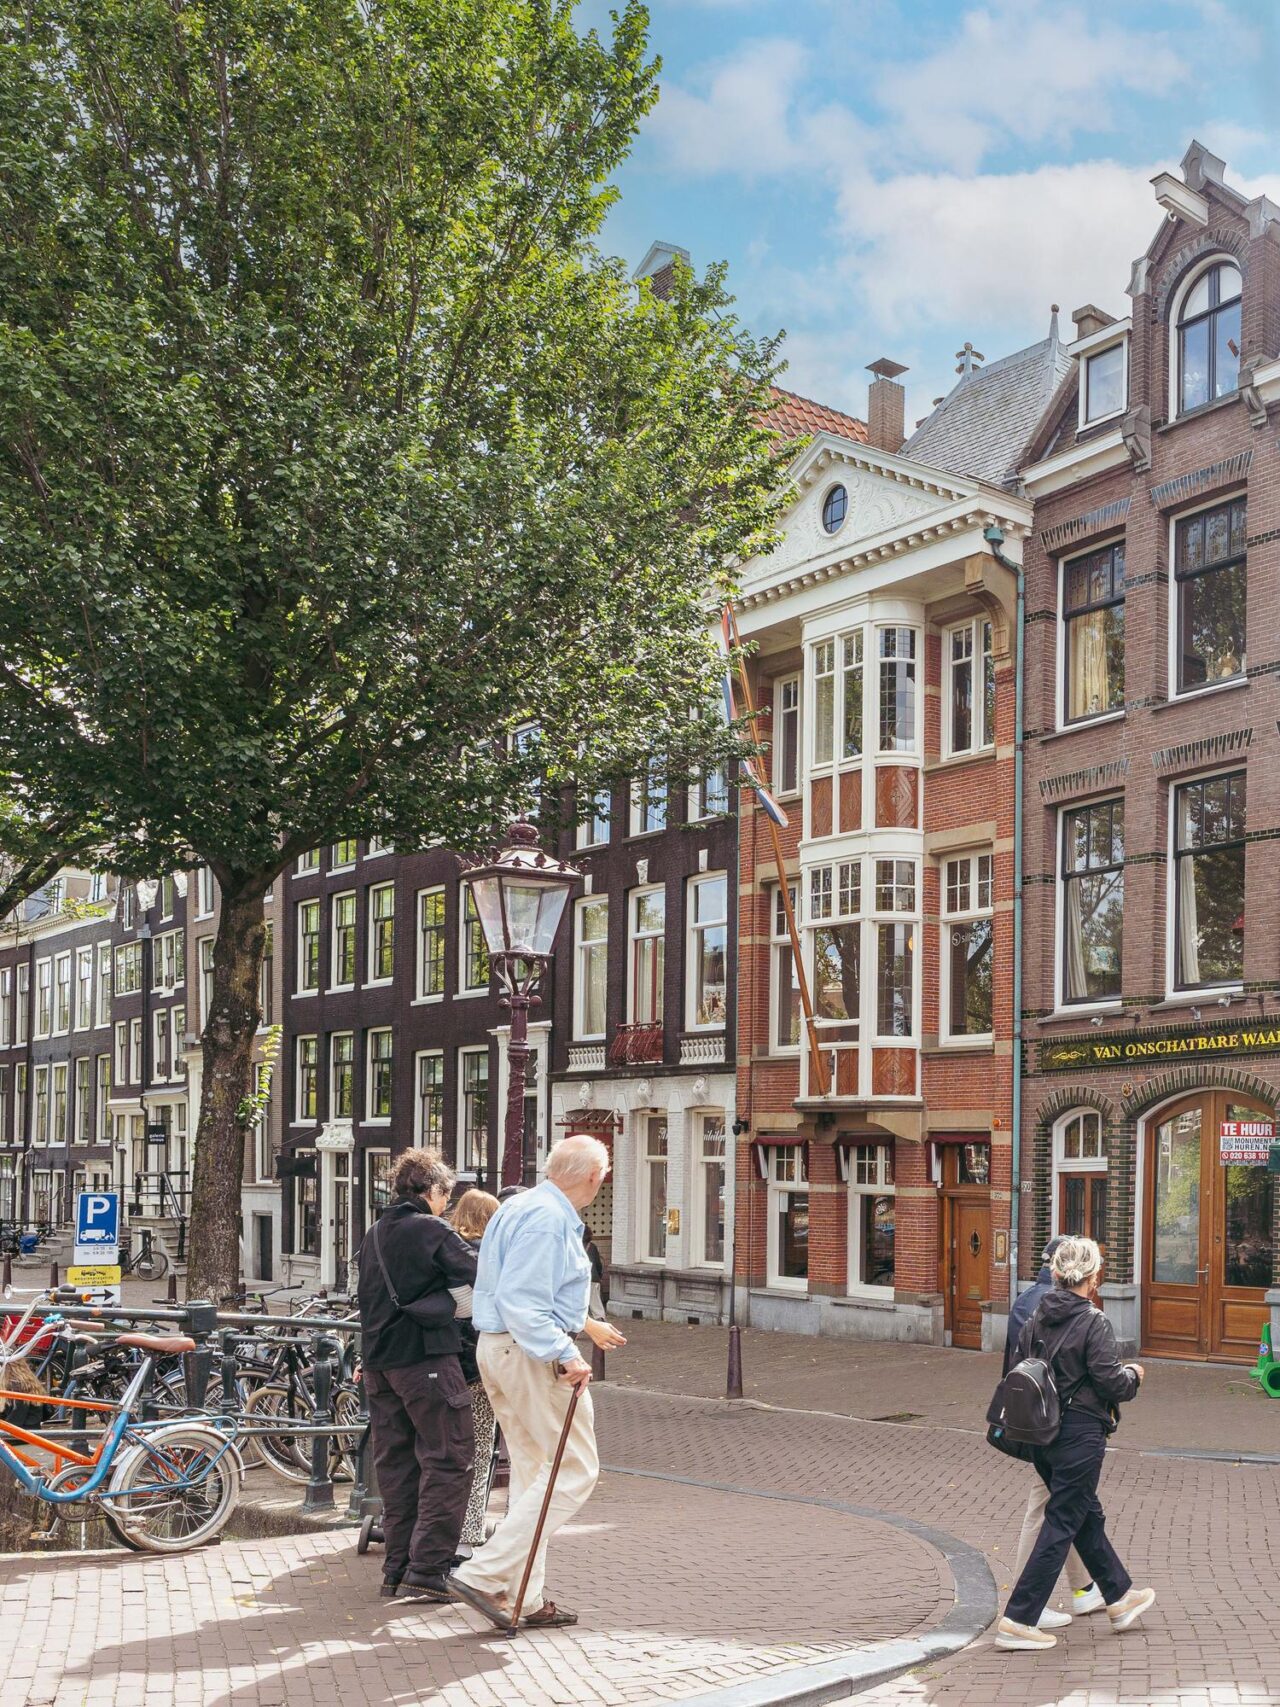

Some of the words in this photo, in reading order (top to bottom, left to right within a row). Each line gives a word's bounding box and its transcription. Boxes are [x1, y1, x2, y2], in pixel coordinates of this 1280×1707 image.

[1093, 1044, 1122, 1059] VAN
[1125, 1034, 1239, 1057] ONSCHATBARE
[1222, 1123, 1238, 1136] TE
[1240, 1123, 1273, 1136] HUUR
[1229, 1152, 1243, 1160] 020
[1258, 1152, 1269, 1160] 101
[87, 1197, 110, 1223] P
